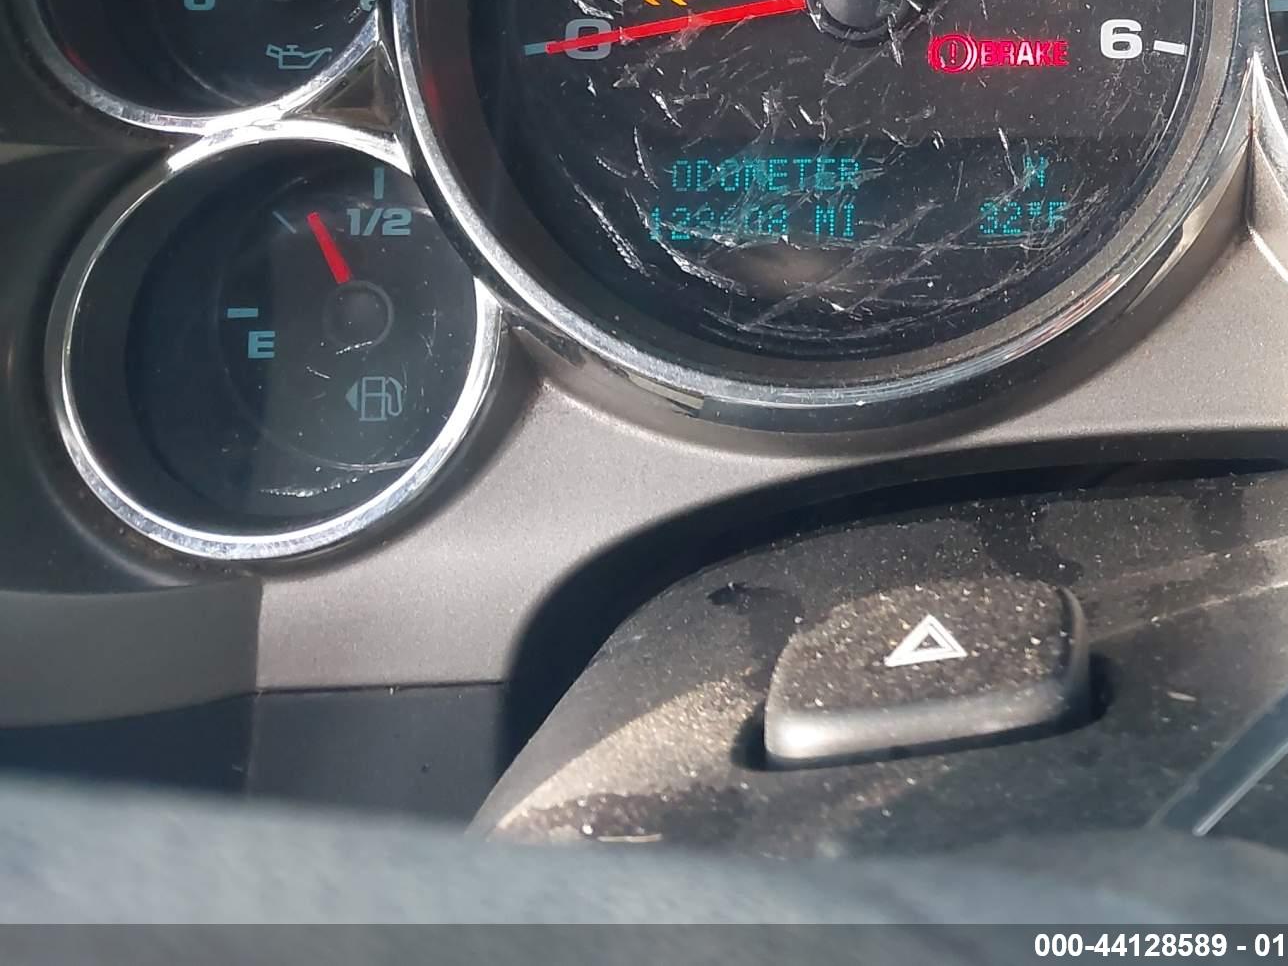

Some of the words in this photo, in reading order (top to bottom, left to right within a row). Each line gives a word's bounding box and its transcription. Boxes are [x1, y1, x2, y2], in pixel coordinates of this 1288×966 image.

[565, 19, 611, 60] 0
[980, 40, 1068, 67] BRAKE
[1100, 19, 1143, 59] 6
[671, 157, 860, 192] ODOMETER
[347, 207, 411, 237] 1/2
[814, 202, 856, 240] MI
[248, 330, 275, 358] E
